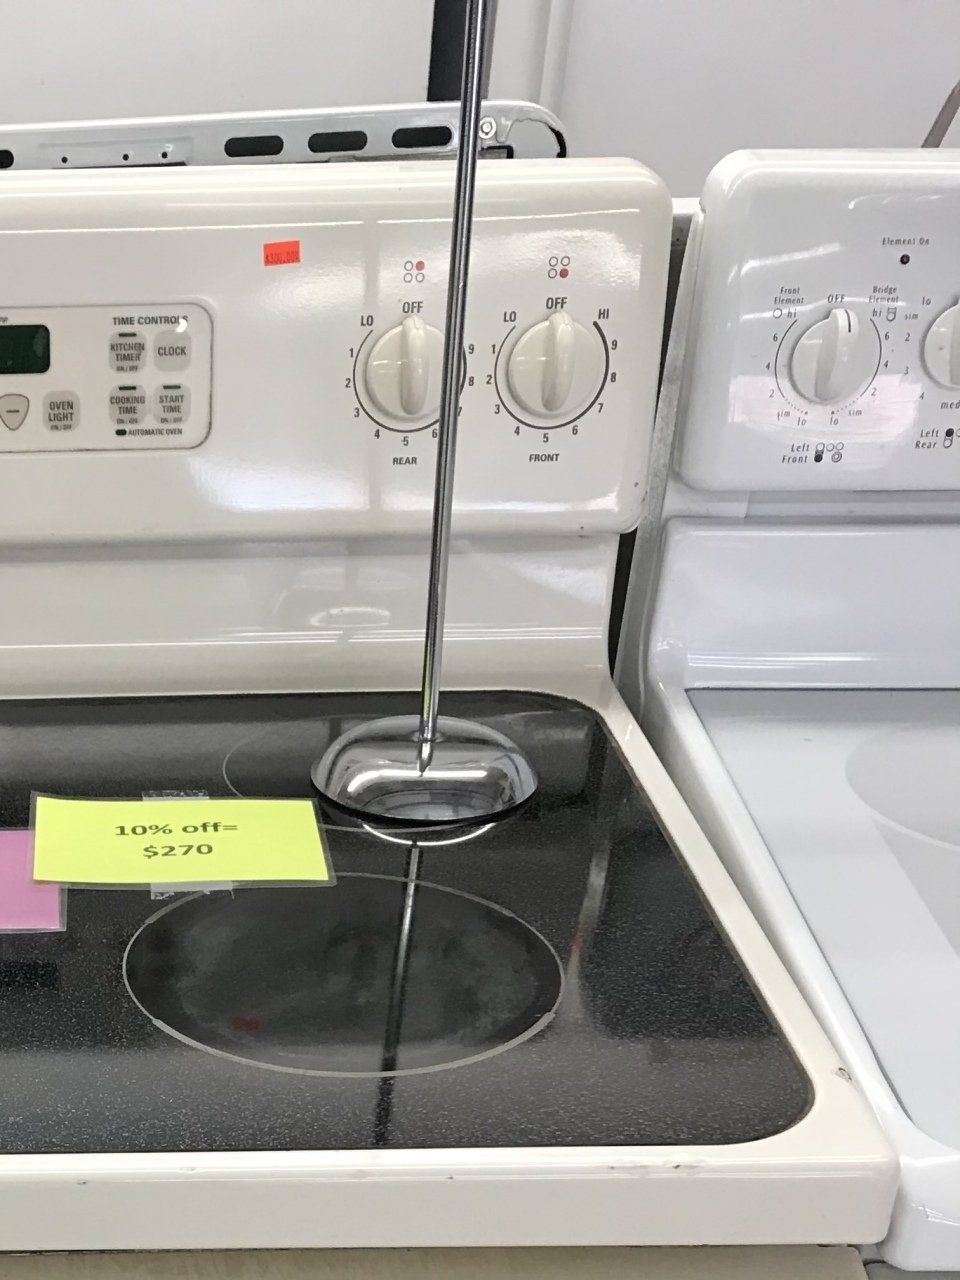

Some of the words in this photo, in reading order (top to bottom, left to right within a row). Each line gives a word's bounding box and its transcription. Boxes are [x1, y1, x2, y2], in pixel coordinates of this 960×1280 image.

[882, 237, 916, 246] Element
[780, 286, 800, 295] Front
[872, 285, 897, 295] Bridge
[545, 297, 568, 310] OFF
[773, 296, 804, 305] Element
[827, 294, 845, 304] OFF
[868, 295, 900, 304] Element
[402, 301, 424, 314] OFF
[787, 308, 797, 318] hi
[872, 308, 882, 318] hi
[503, 311, 517, 323] LO
[598, 308, 610, 320] HI
[112, 317, 135, 325] TIME
[360, 315, 374, 327] LO
[110, 342, 145, 352] KITCHEN
[468, 344, 475, 355] 9
[491, 344, 496, 355] 1
[611, 339, 618, 351] 9
[157, 346, 187, 356] CLOCK
[349, 348, 354, 359] 1
[115, 353, 141, 362] TIMER
[468, 376, 475, 387] 8
[485, 374, 492, 385] 2
[610, 372, 617, 383] 8
[345, 378, 351, 389] 2
[109, 395, 145, 405] COOKING
[159, 394, 184, 403] START
[49, 401, 74, 411] OVEN
[118, 406, 137, 415] TIME
[161, 405, 182, 413] TIME
[494, 404, 500, 415] 3
[597, 403, 604, 414] 7
[48, 410, 74, 422] LIGHT
[353, 407, 360, 418] 3
[374, 428, 380, 440] 4
[431, 428, 438, 439] 6
[514, 425, 520, 437] 4
[572, 425, 578, 436] 6
[920, 428, 939, 438] Left
[403, 436, 409, 447] 5
[542, 433, 549, 444] 5
[791, 443, 810, 453] Left
[915, 441, 937, 449] Rear
[392, 456, 417, 466] REAR
[528, 453, 559, 463] FRONT
[781, 455, 808, 464] Front
[115, 824, 173, 836] 10%
[182, 822, 238, 834] off=
[143, 844, 213, 859] $270
